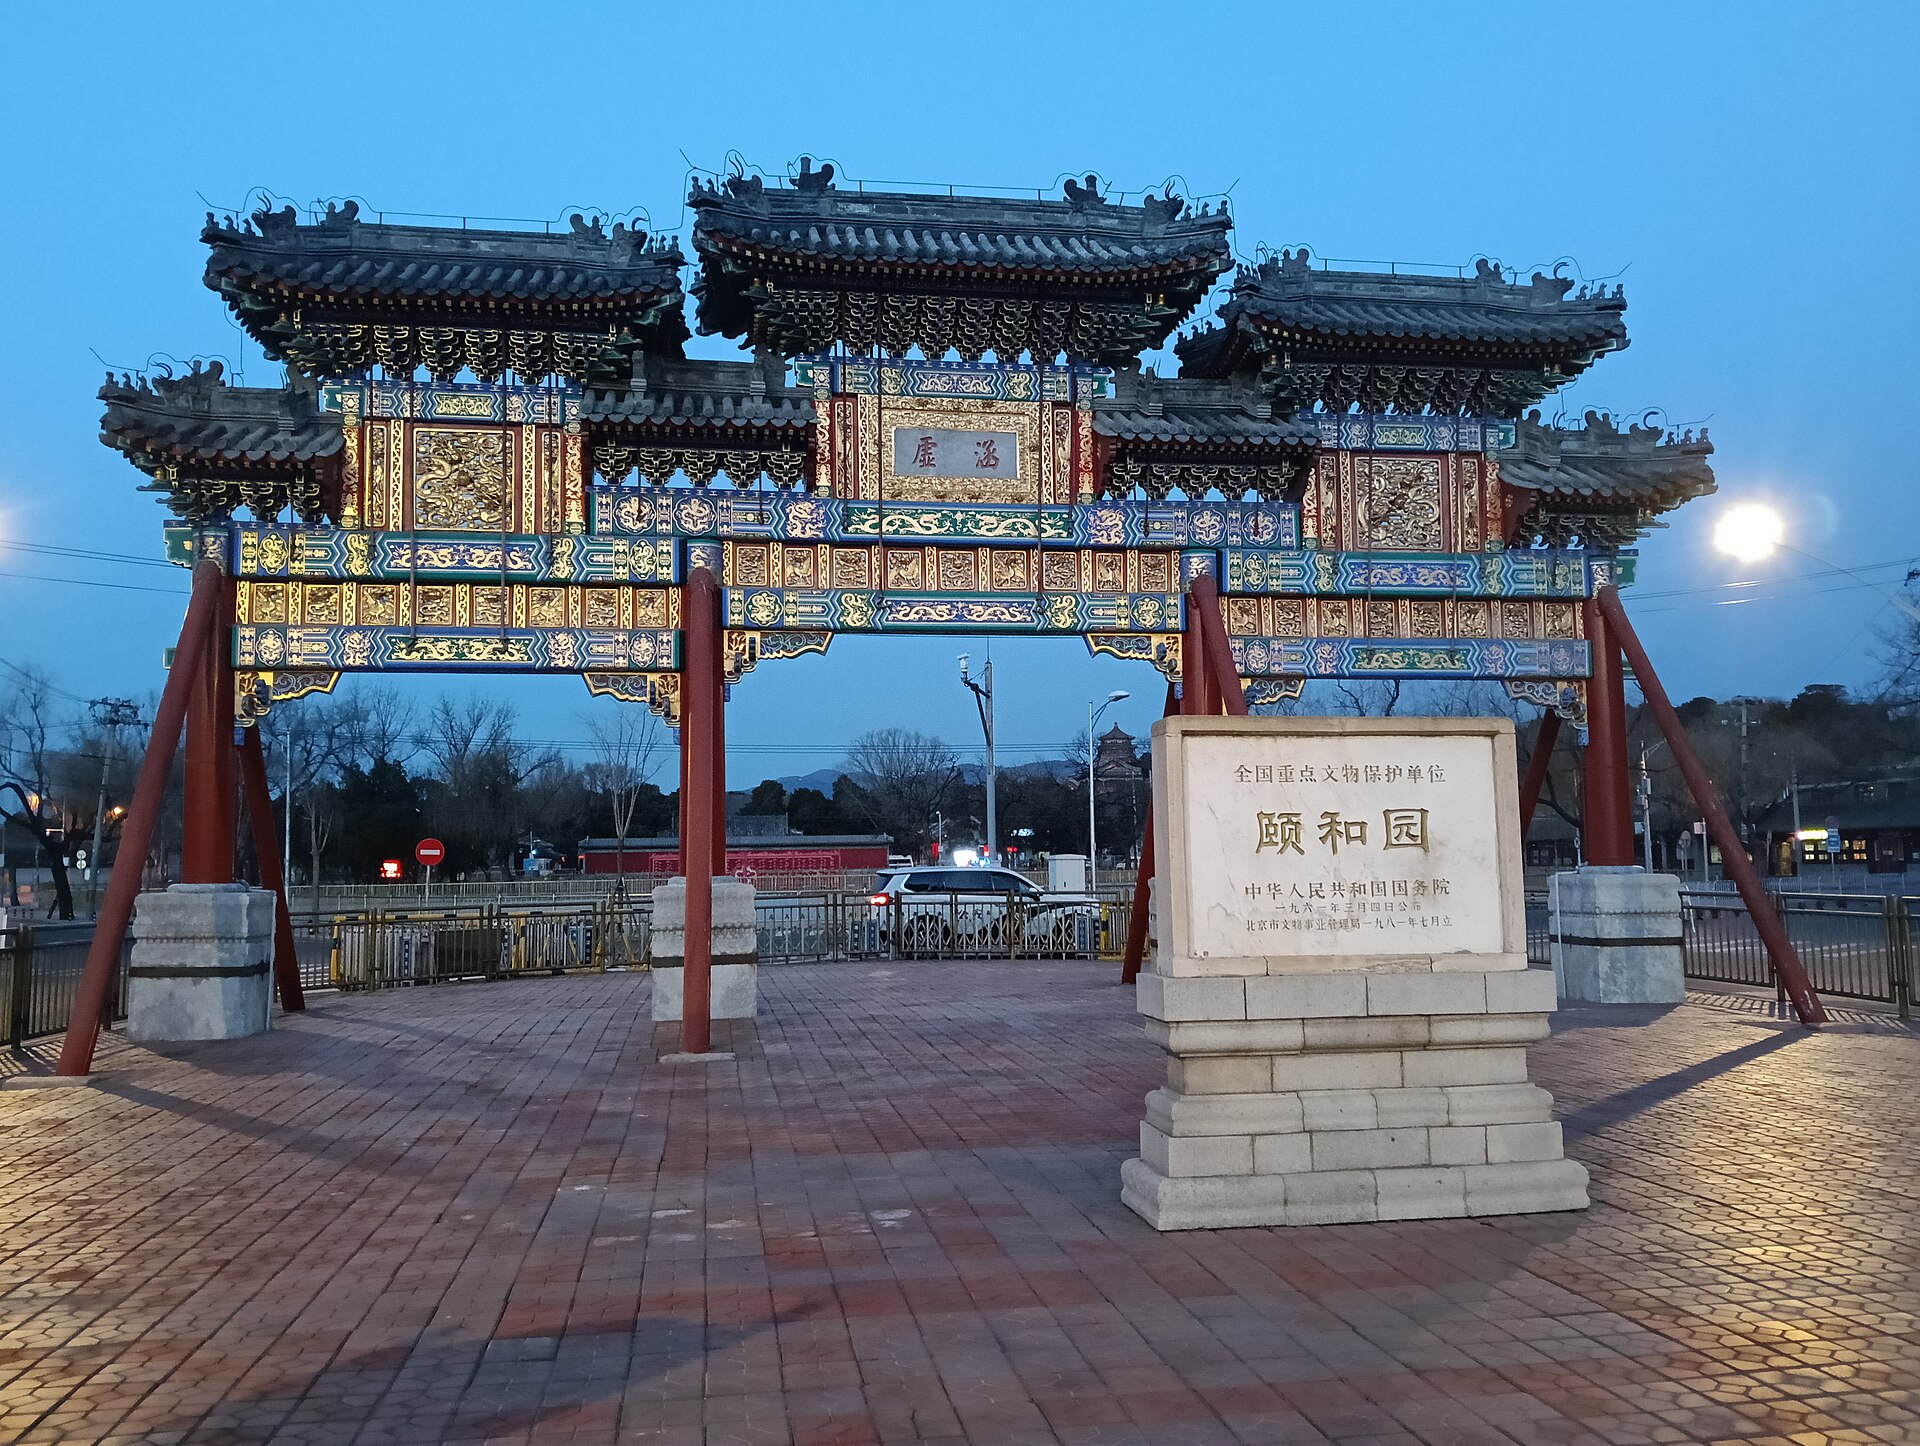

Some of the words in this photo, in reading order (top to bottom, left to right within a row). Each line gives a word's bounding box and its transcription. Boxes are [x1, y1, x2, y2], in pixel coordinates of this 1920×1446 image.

[1234, 763, 1446, 784] 全国重点文物保护单位
[1255, 807, 1431, 856] 颐和园
[1244, 878, 1450, 900] 中华人民共和国国务院
[1275, 901, 1422, 914] 一九六一年三月四日公布
[1246, 915, 1453, 932] 北京市文物事业管理局一九八一年七月立
